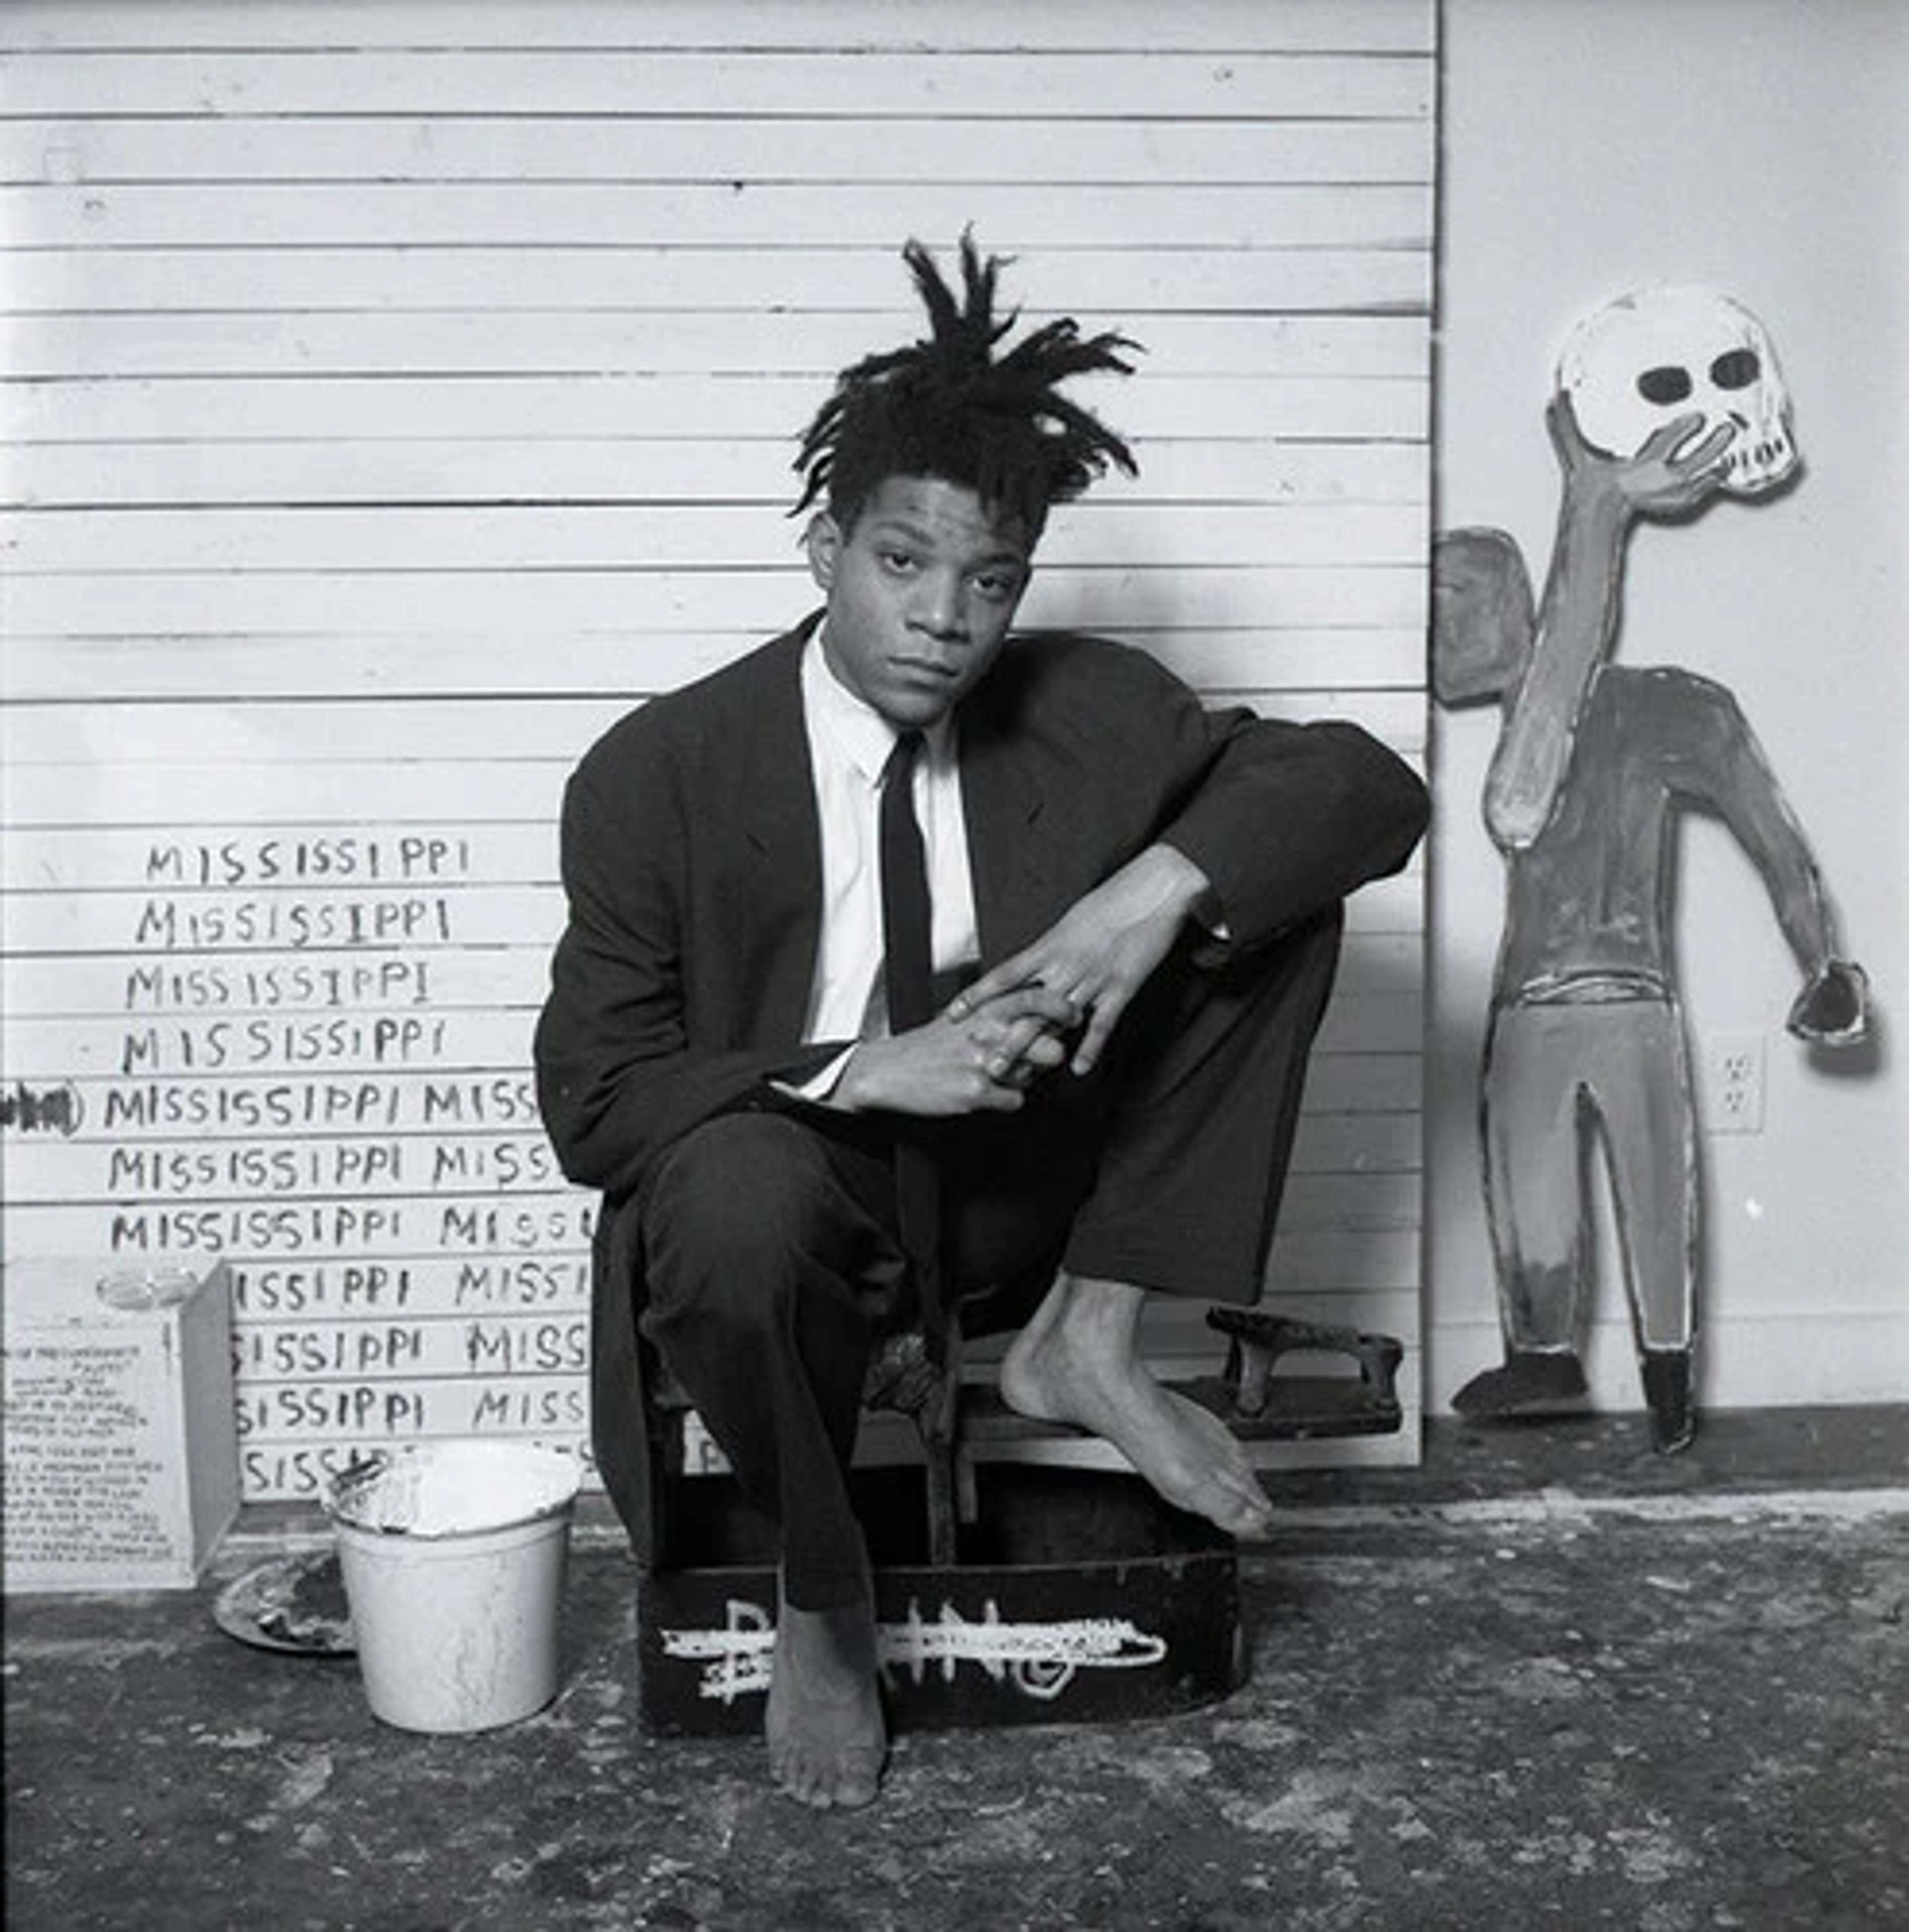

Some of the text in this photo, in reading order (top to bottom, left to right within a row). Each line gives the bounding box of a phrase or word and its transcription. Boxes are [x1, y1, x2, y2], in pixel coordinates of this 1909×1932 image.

[146, 837, 469, 885] MISSISSIPPI
[135, 898, 450, 947] MISSISSIPPI
[125, 960, 431, 1010] MISSISSIPPI
[121, 1017, 446, 1075] MISSISSIPPI
[103, 1083, 400, 1128] MISSISSIPPI
[108, 1143, 401, 1193] MISSISSIPPI
[111, 1206, 400, 1253] MISSISSIPPI
